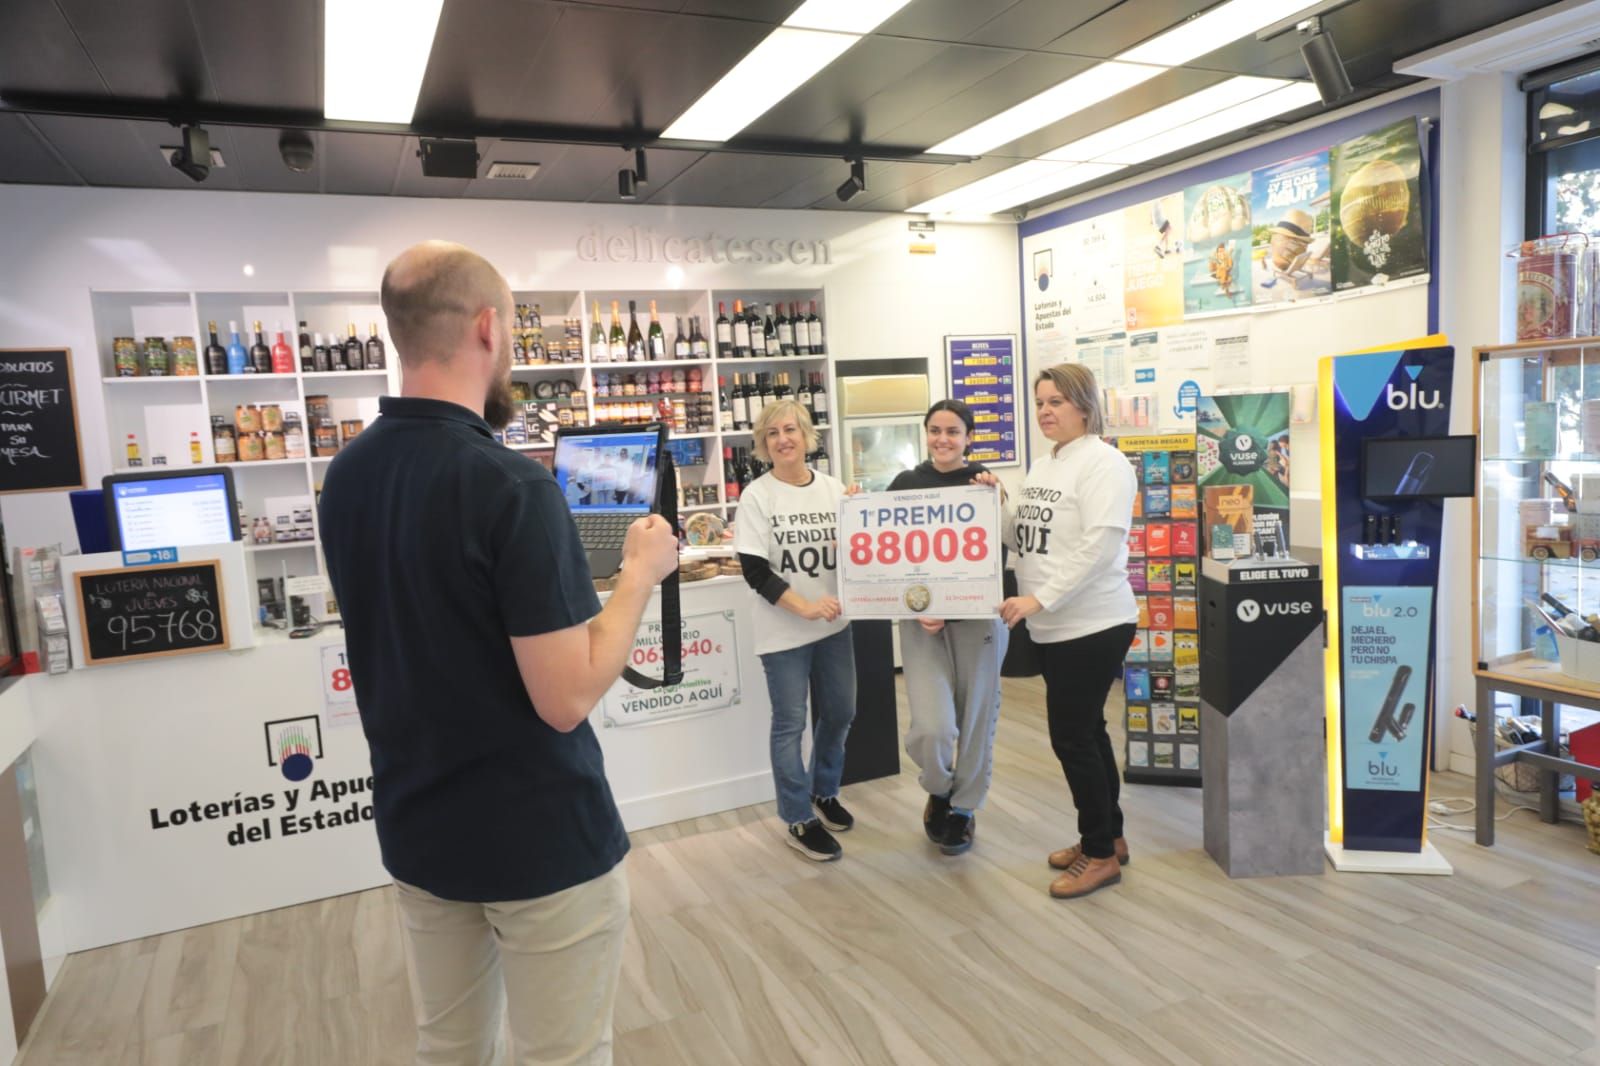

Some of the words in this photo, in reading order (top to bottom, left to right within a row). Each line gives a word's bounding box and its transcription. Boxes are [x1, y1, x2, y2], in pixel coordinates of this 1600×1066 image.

[577, 225, 833, 264] delicatessen
[877, 503, 975, 527] PREMIO
[849, 526, 988, 565] 88008
[1240, 570, 1267, 581] ELIGE
[1269, 569, 1280, 579] EL
[1281, 568, 1309, 579] TUYO
[107, 609, 217, 651] 95768
[1351, 625, 1375, 634] DEJA
[1376, 625, 1387, 634] EL
[1351, 635, 1396, 645] MECHERO
[1351, 646, 1375, 654] PERO
[1376, 645, 1390, 655] NO
[1351, 656, 1363, 664] TU
[1364, 656, 1398, 664] CHISPA
[621, 693, 684, 713] VENDIDO
[688, 683, 723, 701] AQUÍ
[150, 792, 275, 829] Loterías
[284, 789, 299, 811] y
[227, 818, 271, 846] del
[280, 802, 374, 836] Estado
